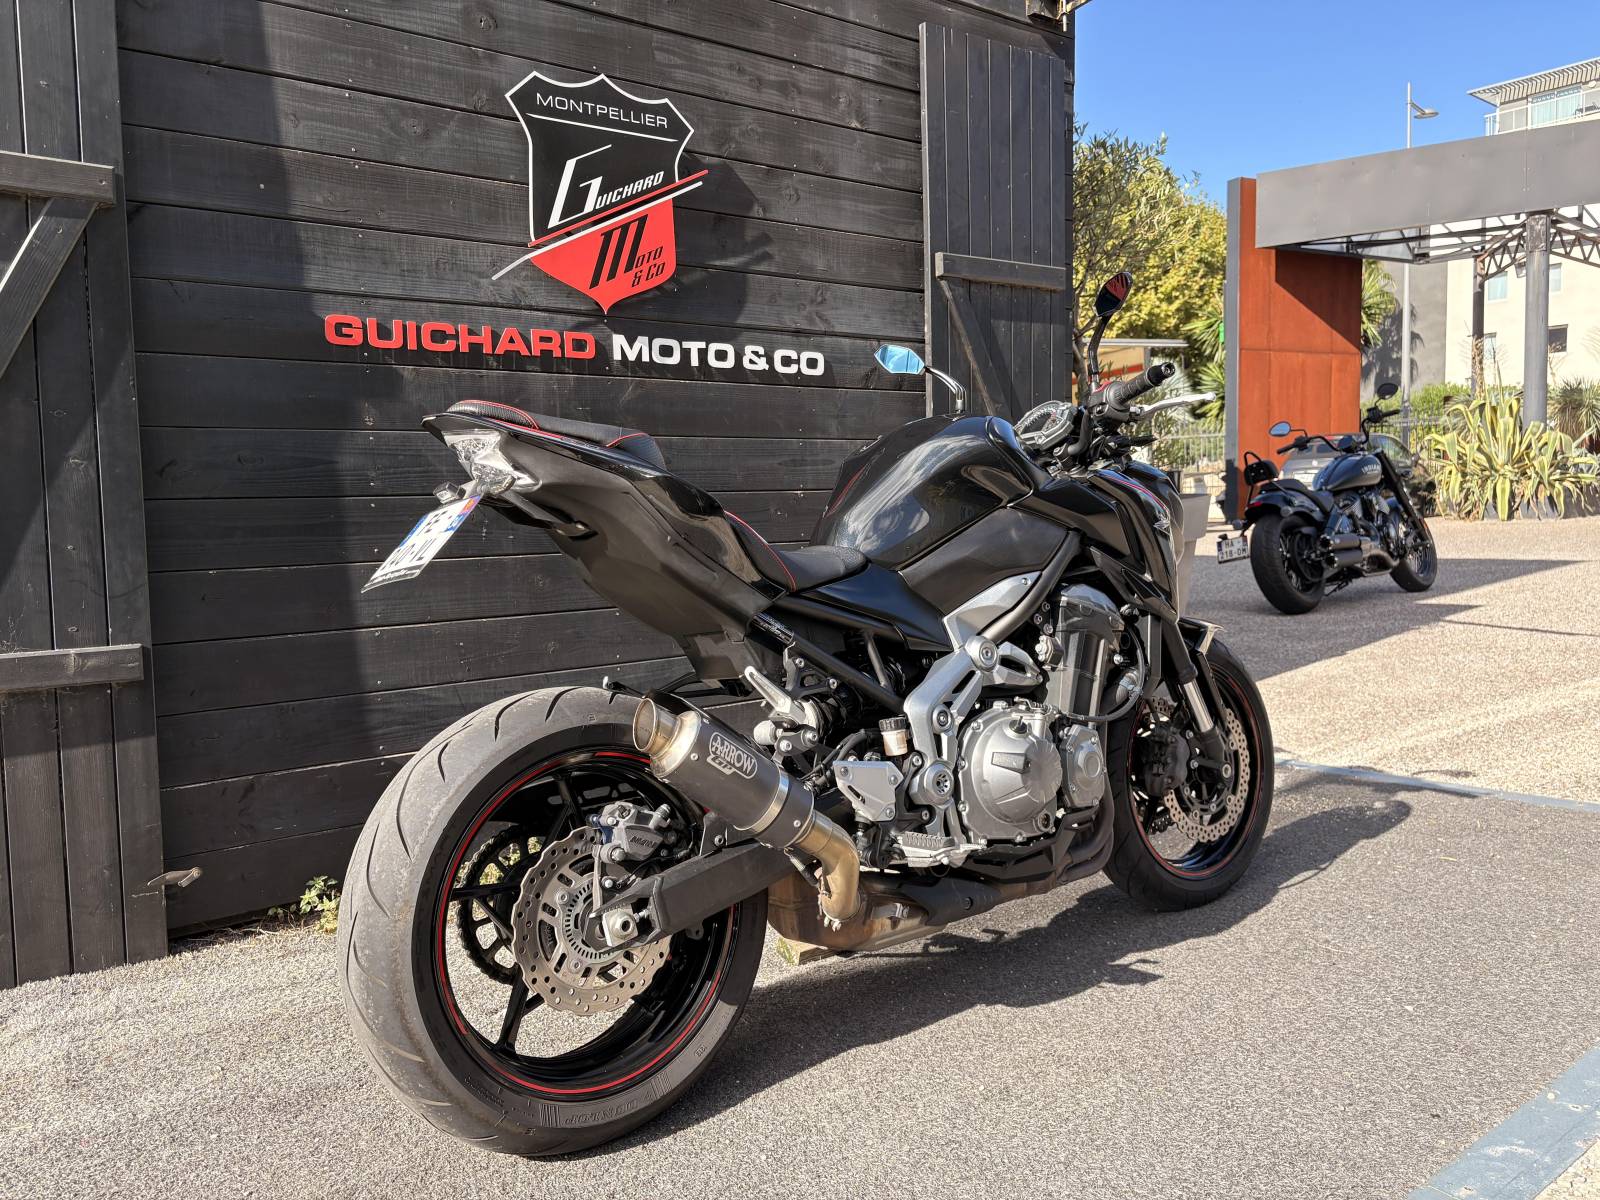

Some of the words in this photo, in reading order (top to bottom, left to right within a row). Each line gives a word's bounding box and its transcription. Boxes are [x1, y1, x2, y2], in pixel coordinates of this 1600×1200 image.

[536, 92, 668, 129] MONTPELLIER
[547, 144, 665, 229] GUICHARD
[324, 313, 596, 360] GUICHARD
[711, 735, 756, 775] ARROW
